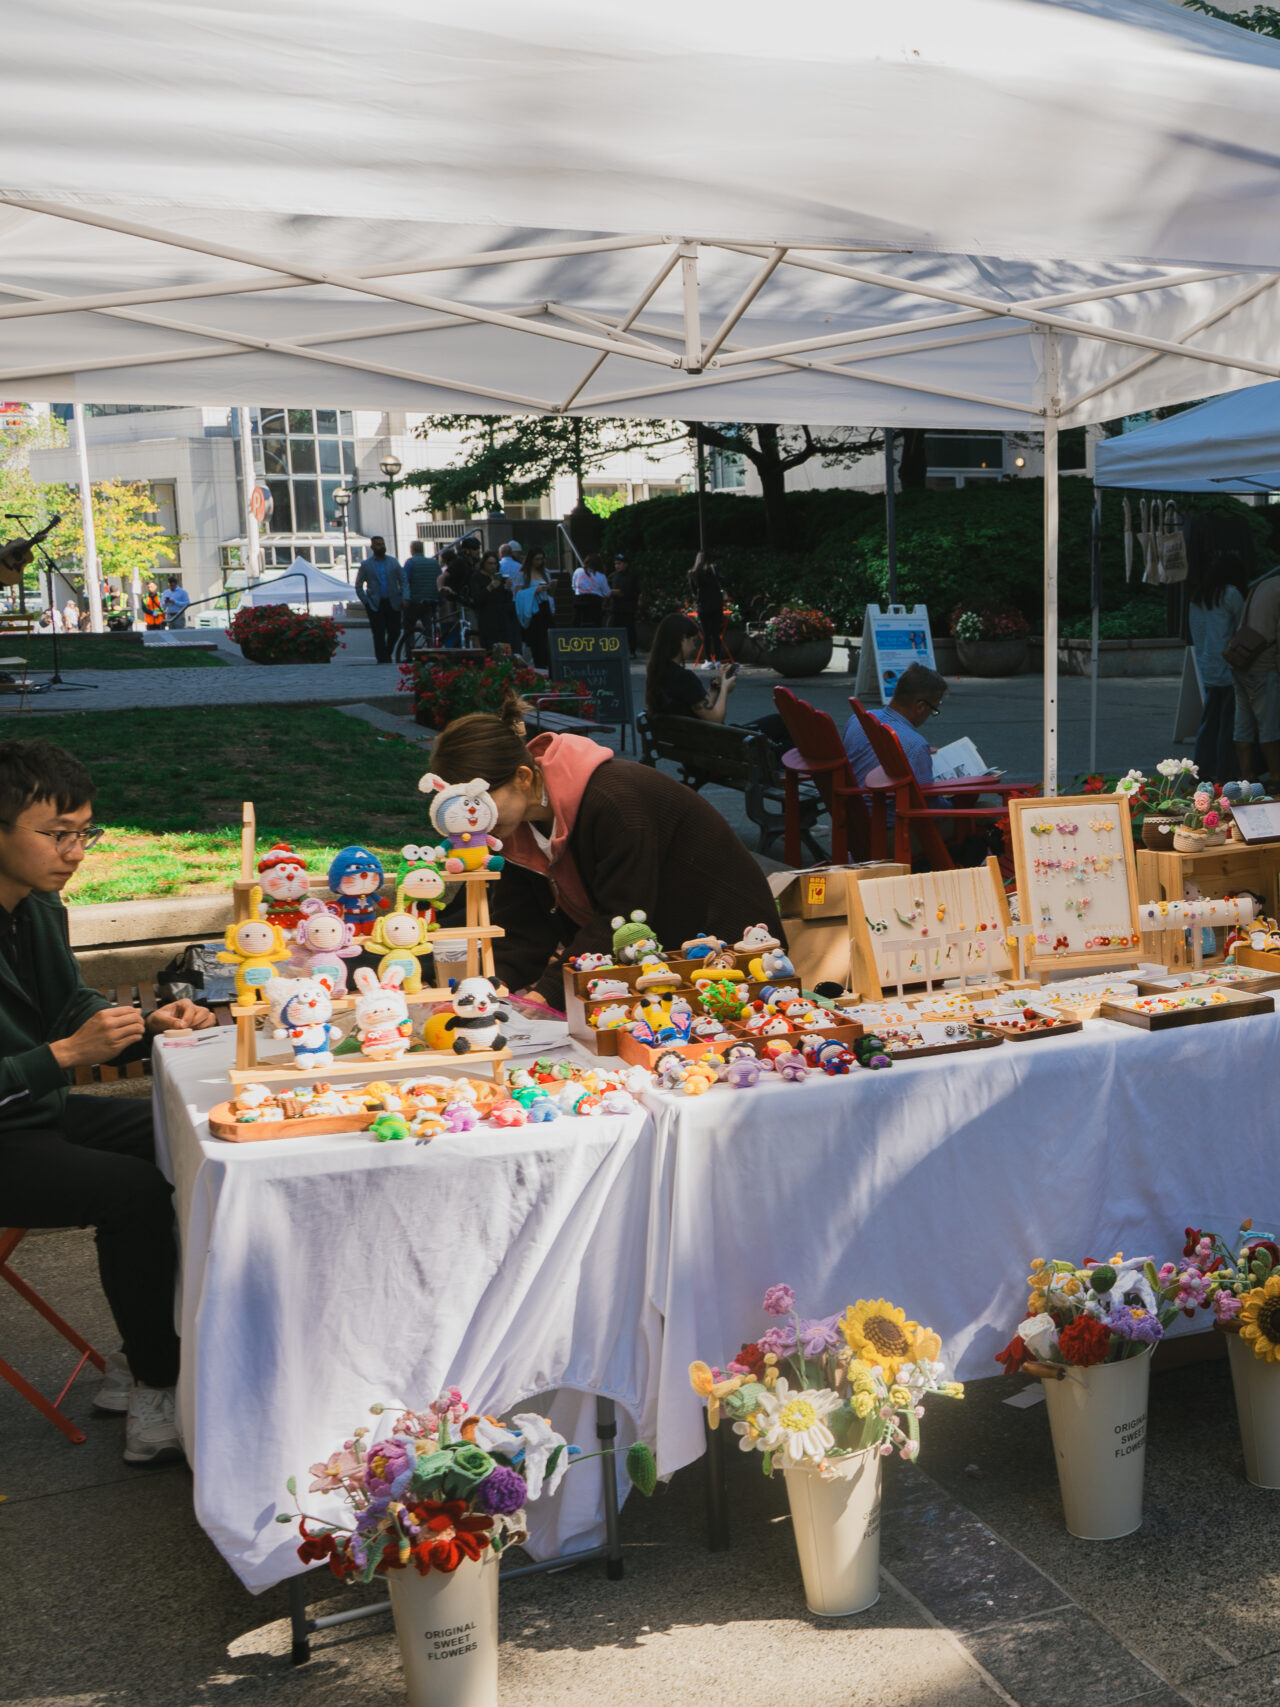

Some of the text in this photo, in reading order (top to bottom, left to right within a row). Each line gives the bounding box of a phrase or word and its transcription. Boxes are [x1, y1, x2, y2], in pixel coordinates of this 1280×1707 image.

[558, 637, 620, 652] LOT 19
[424, 1621, 478, 1640] ORIGINAL
[433, 1634, 471, 1650] SWEET
[427, 1642, 478, 1661] FLOWERS
